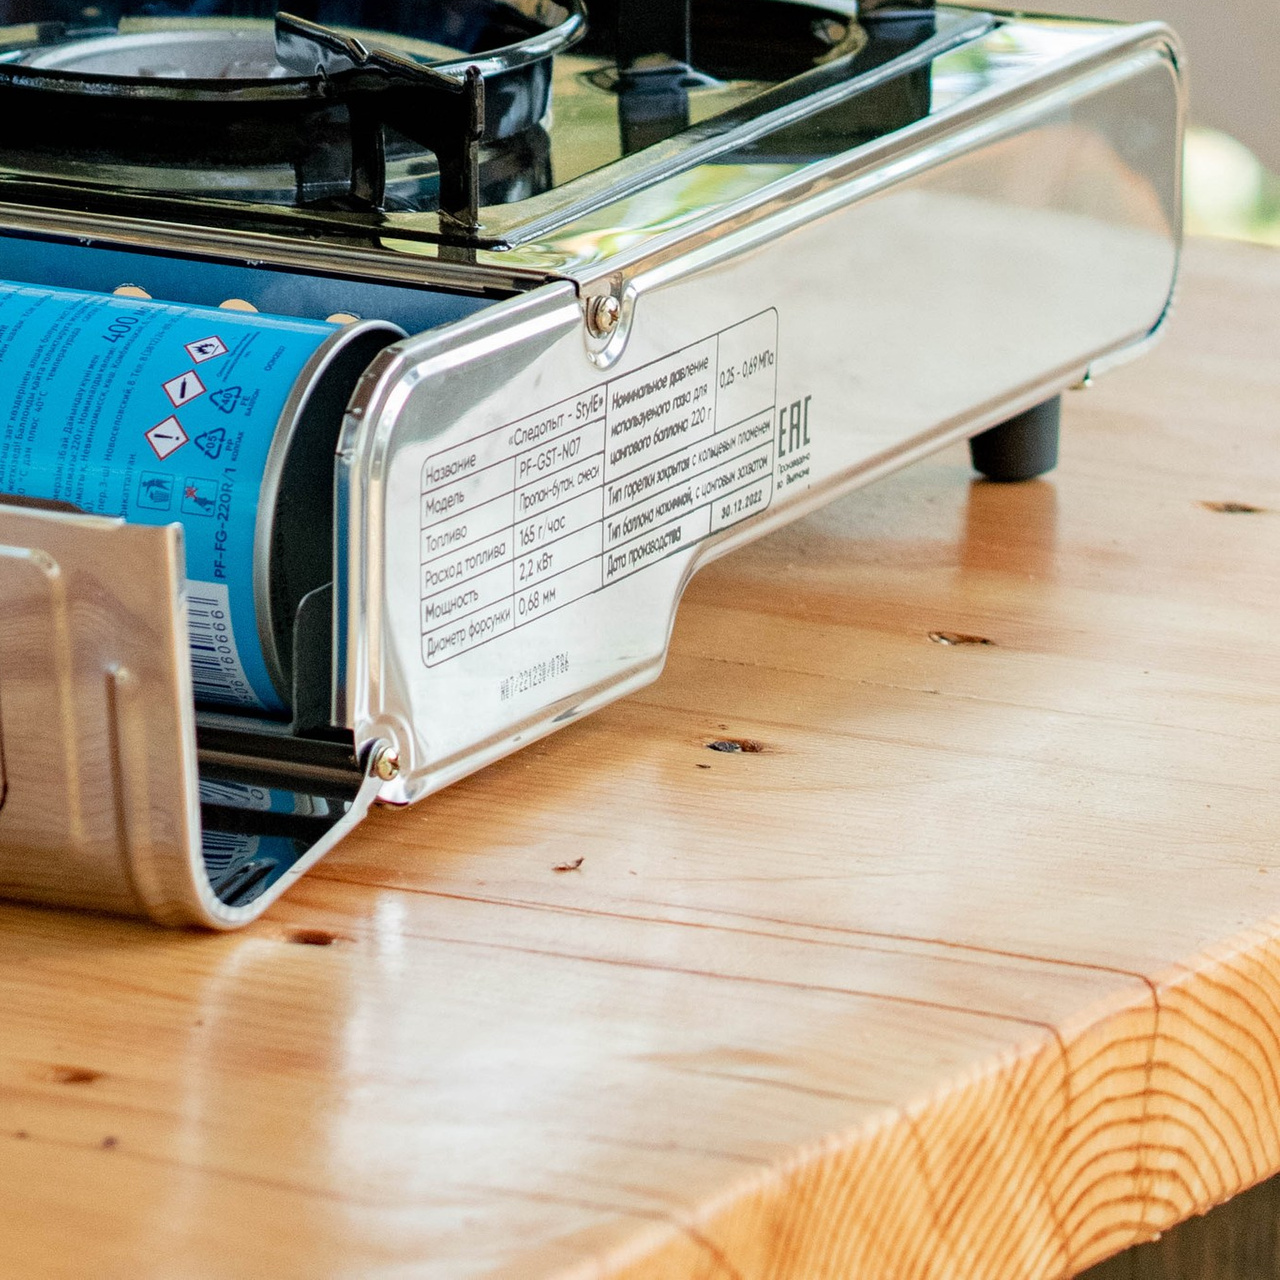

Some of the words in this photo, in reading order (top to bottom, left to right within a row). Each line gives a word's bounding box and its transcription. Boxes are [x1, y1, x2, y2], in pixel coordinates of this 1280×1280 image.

[100, 315, 139, 344] 400
[611, 374, 668, 410] Номинальное
[668, 355, 709, 388] давление
[718, 365, 735, 389] 0,25
[741, 354, 758, 378] 0,69
[757, 348, 774, 368] МПа
[14, 391, 36, 440] Баллонды
[220, 391, 233, 405] 40
[610, 399, 671, 437] используемого
[692, 382, 708, 401] для
[26, 416, 40, 442] плюс
[69, 432, 82, 451] 220
[102, 387, 133, 462] Новоселовский,
[204, 434, 218, 449] 05
[609, 433, 652, 466] цангового
[652, 417, 689, 445] баллона
[689, 405, 706, 428] 220
[779, 394, 812, 458] EAC
[425, 453, 477, 483] Название
[507, 412, 565, 446] «Следопыт
[519, 435, 581, 475] PF-GST-N07
[576, 465, 600, 485] смеси
[606, 485, 622, 505] Тип
[623, 472, 656, 499] горелки
[655, 456, 690, 484] закрытая
[697, 437, 736, 462] кольцевым
[425, 491, 465, 514] Модель
[606, 521, 621, 542] Тип
[621, 507, 654, 536] баллона
[700, 471, 736, 496] цанговым
[720, 488, 763, 520] 30.12.2022
[214, 467, 236, 579] PF-FG-220R/1
[424, 524, 467, 552] Топливо
[518, 523, 535, 546] 165
[537, 514, 566, 538] г/час
[424, 560, 463, 586] Расход
[463, 541, 506, 569] топлива
[518, 557, 534, 581] 2,2
[536, 551, 554, 572] кВт
[605, 552, 627, 577] Дата
[627, 525, 682, 564] производства
[424, 588, 479, 622] Мощность
[518, 589, 539, 616] 0,68
[541, 588, 556, 600] мм
[426, 627, 466, 659] Диаметр
[468, 608, 511, 639] форсунки
